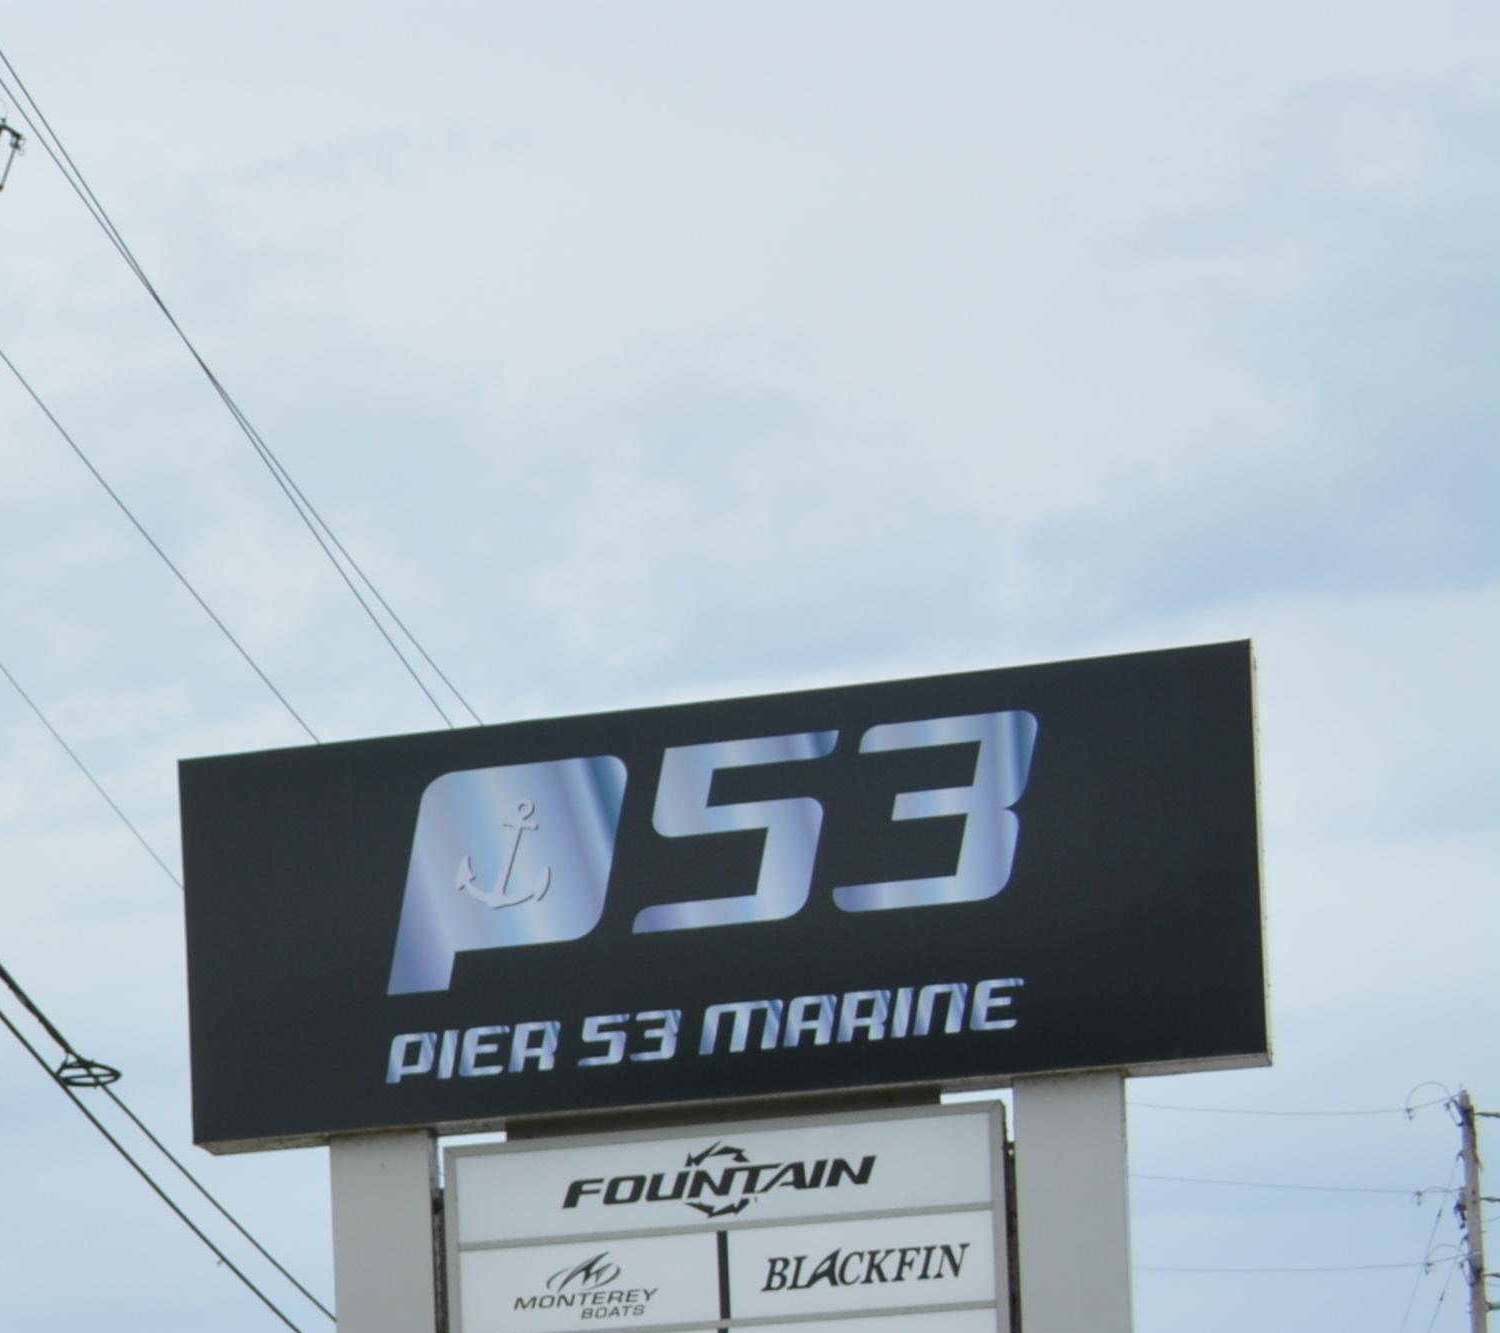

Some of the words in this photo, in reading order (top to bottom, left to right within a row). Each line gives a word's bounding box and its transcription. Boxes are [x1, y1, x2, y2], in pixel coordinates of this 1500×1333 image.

[385, 1021, 560, 1085] PIER
[576, 1009, 682, 1069] 53
[699, 978, 1024, 1053] MARINE
[562, 1155, 876, 1208] FOUNTAIN
[760, 1243, 970, 1292] BLACKFIN
[513, 1288, 658, 1311] MONTEREY
[581, 1304, 646, 1320] BOATS
